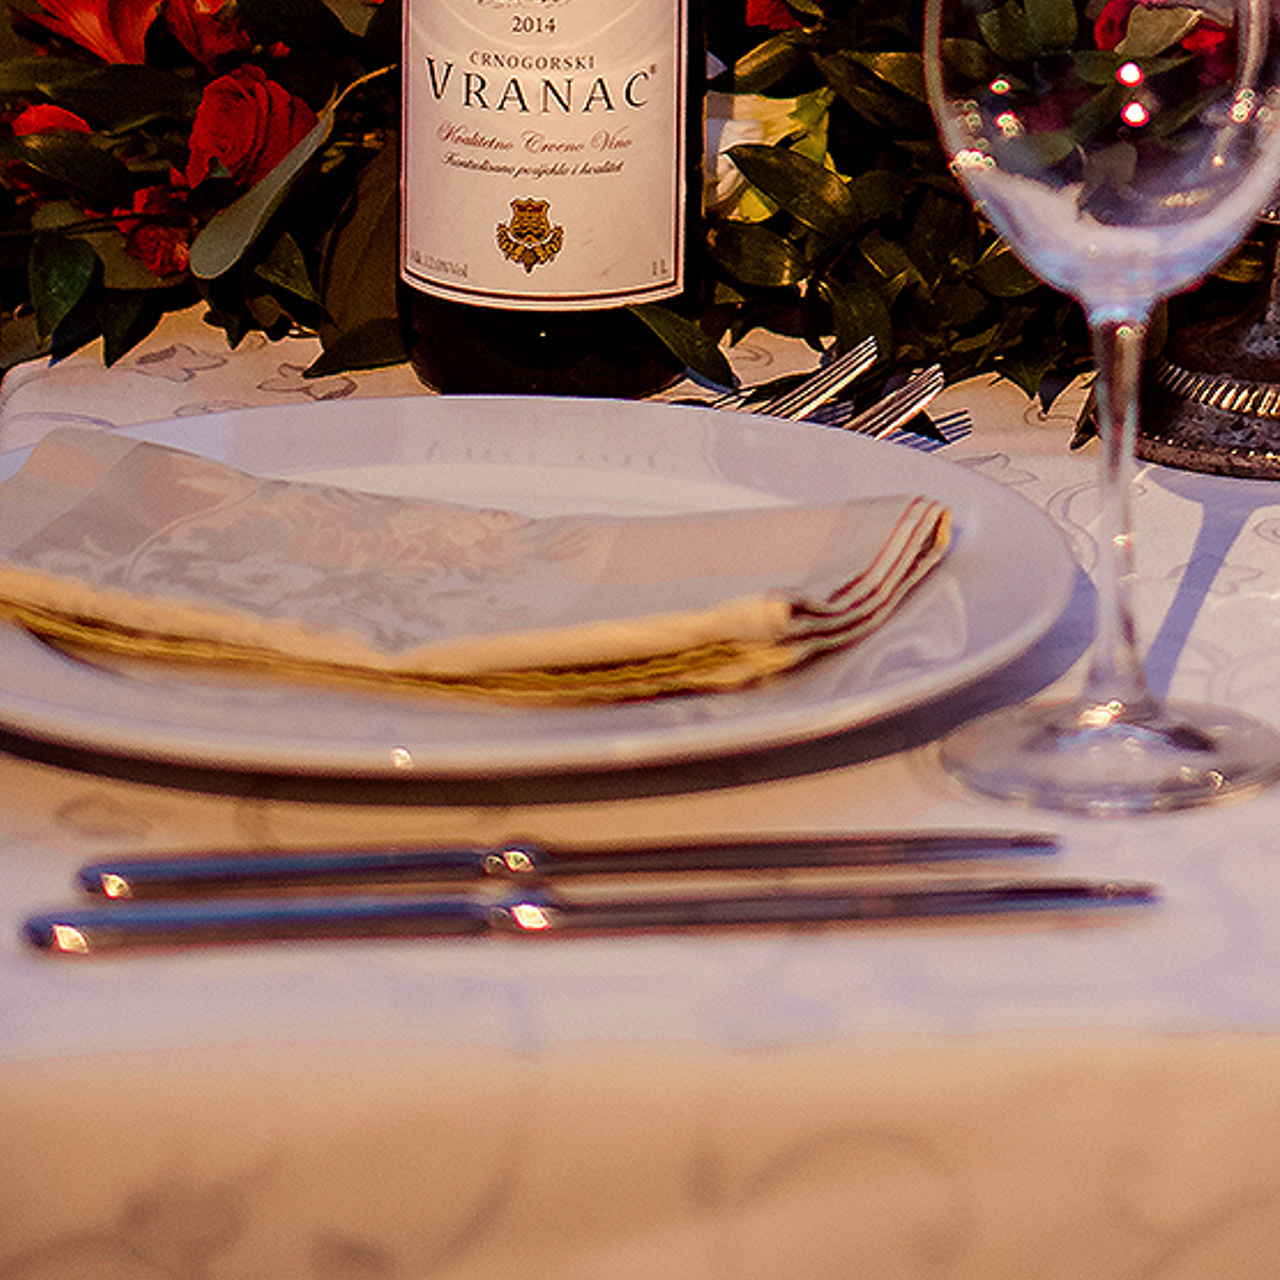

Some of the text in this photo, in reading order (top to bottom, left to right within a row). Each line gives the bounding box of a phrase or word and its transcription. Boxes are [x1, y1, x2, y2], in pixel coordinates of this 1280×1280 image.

[512, 15, 556, 33] 2014
[469, 50, 595, 70] CRNOGORSKI
[520, 129, 584, 154] Crveno
[591, 124, 633, 152] Vino
